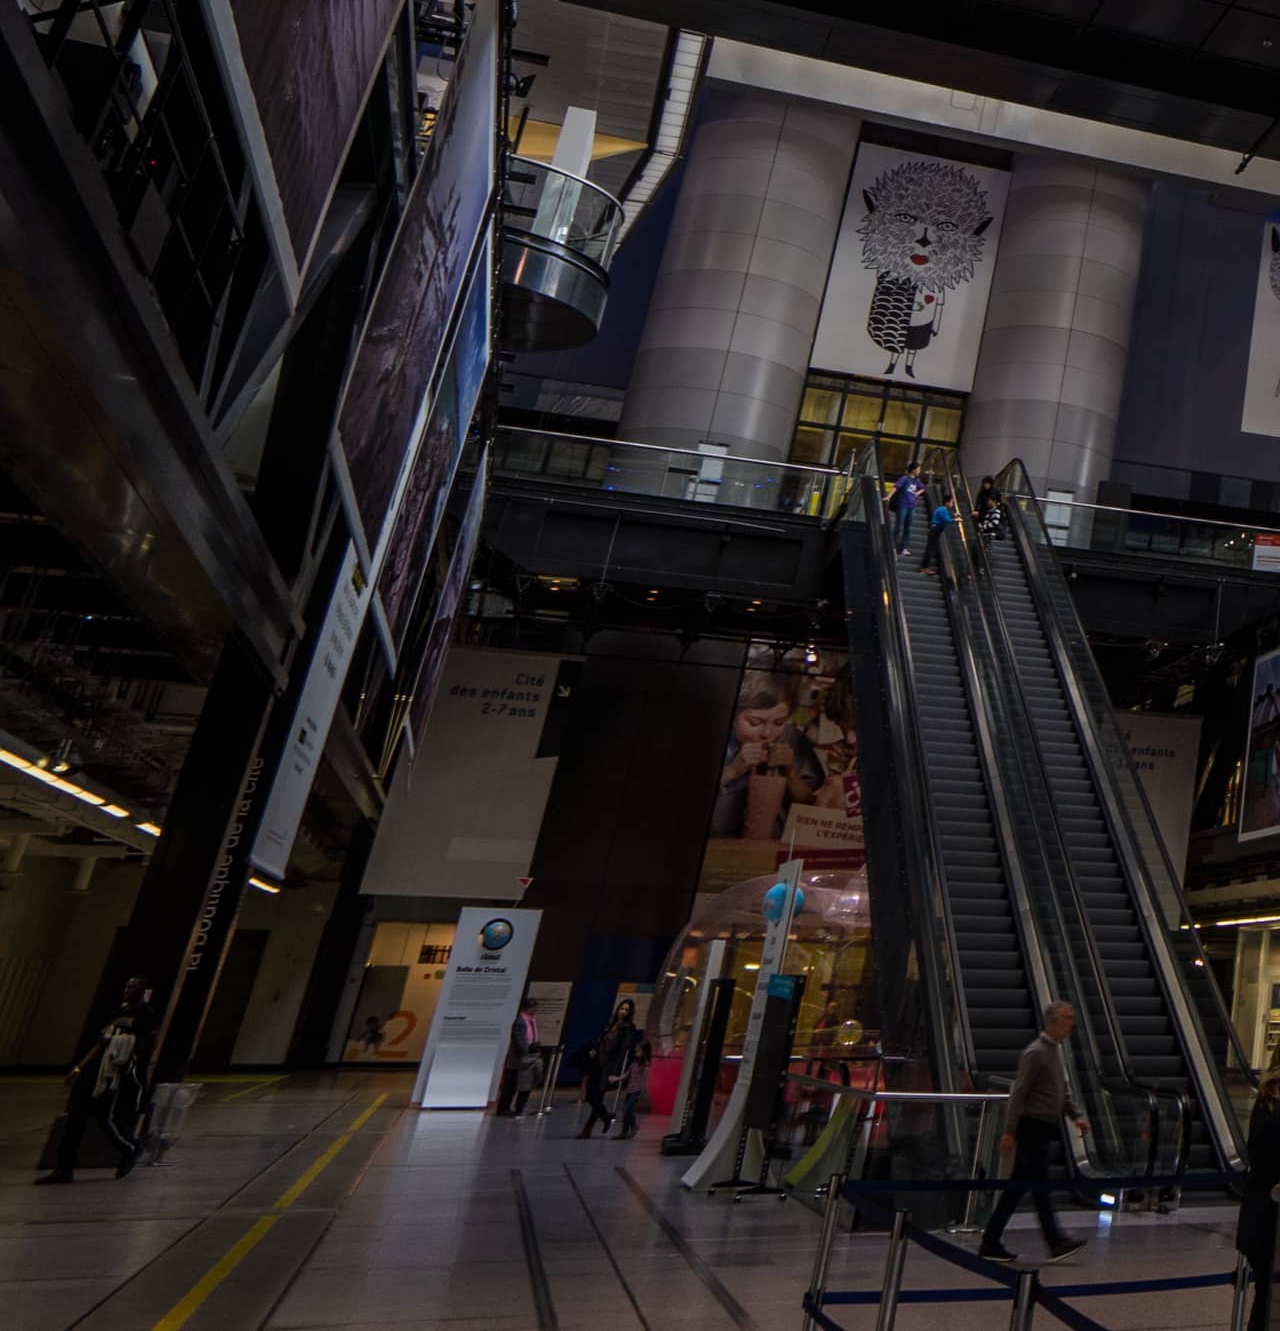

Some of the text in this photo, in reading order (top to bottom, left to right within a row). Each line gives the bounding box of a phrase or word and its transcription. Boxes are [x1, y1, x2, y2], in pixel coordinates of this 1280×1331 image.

[515, 672, 545, 686] Cité
[450, 684, 541, 702] des enfants
[481, 702, 536, 718] 2-7 ans
[820, 820, 834, 829] NE
